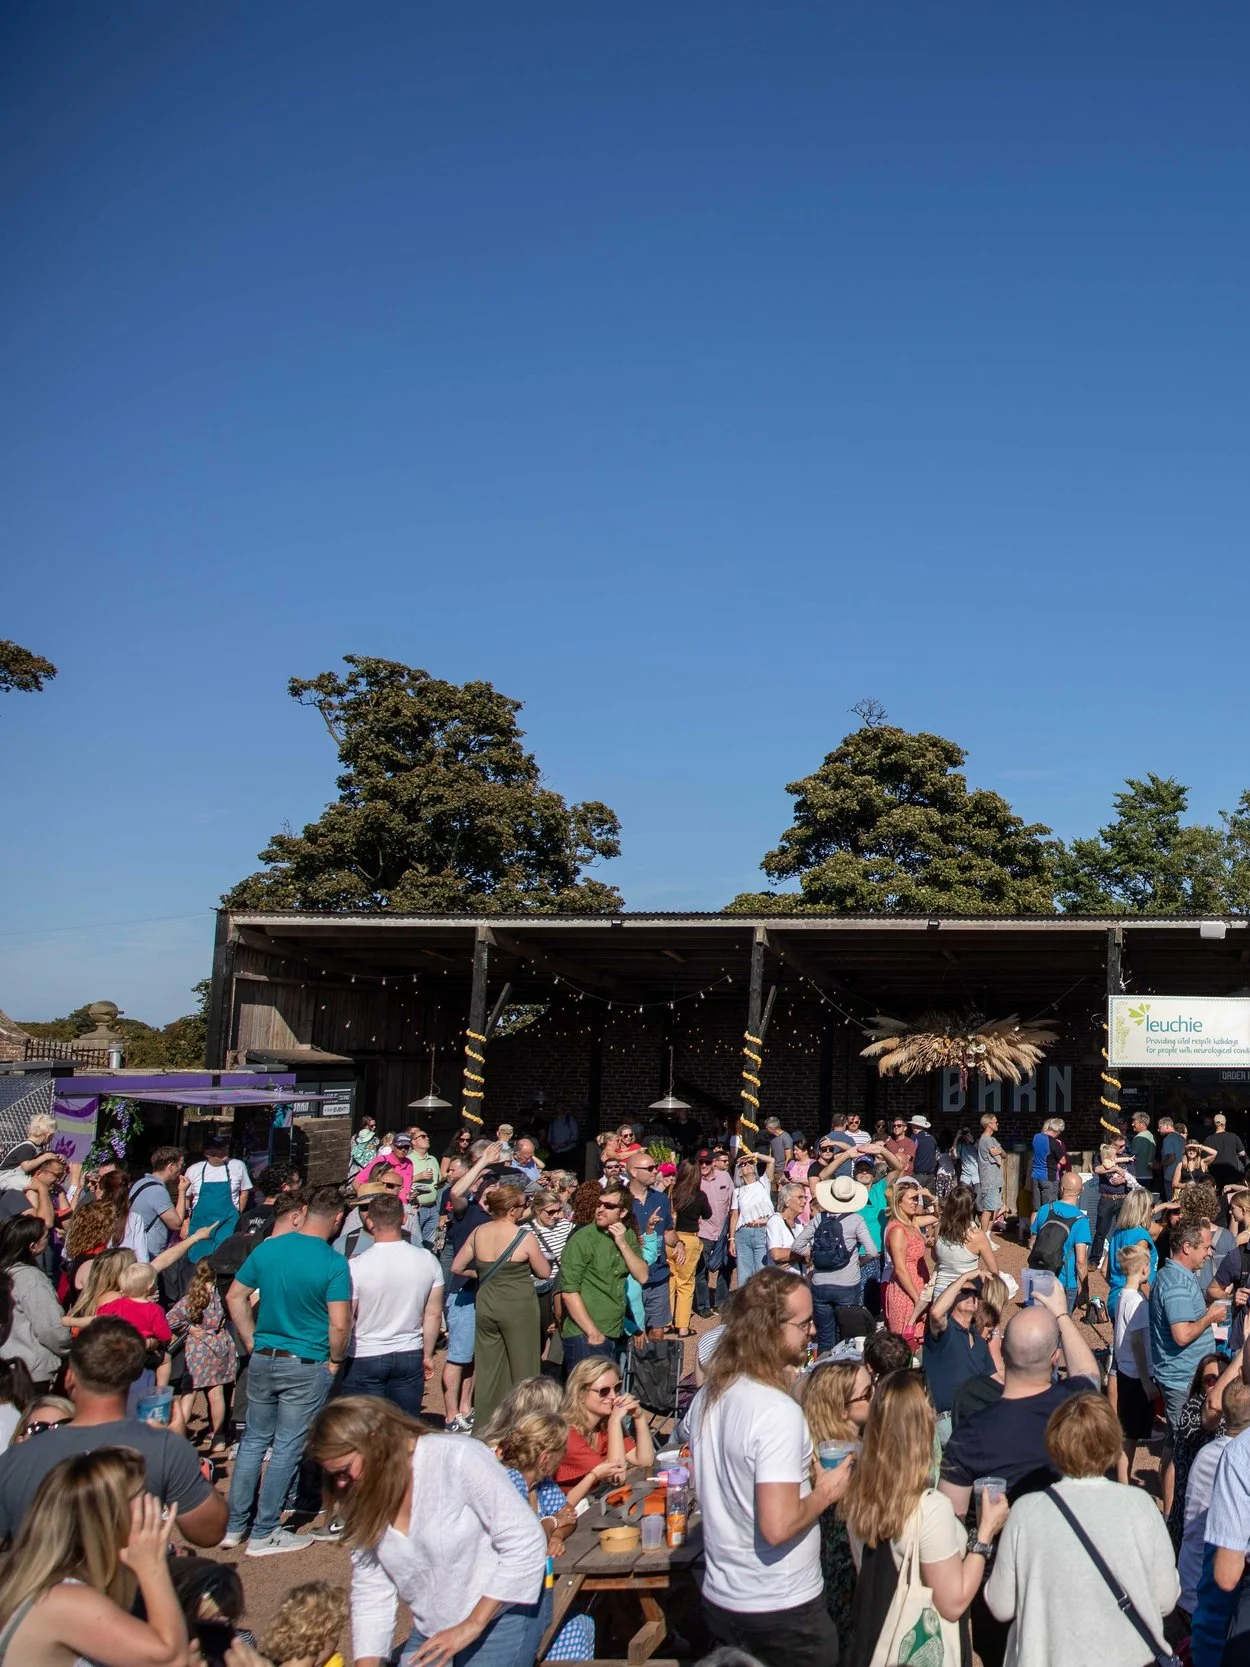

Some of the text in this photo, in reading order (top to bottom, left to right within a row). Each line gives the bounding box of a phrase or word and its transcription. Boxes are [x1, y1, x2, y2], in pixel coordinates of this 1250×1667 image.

[1146, 1014, 1202, 1032] leuchie
[1146, 1036, 1238, 1047] Providing vital respite holidays
[1146, 1046, 1157, 1054] for
[1157, 1046, 1178, 1056] people
[1179, 1046, 1193, 1054] with
[1193, 1046, 1232, 1056] neurological
[1222, 1070, 1246, 1080] ORDER
